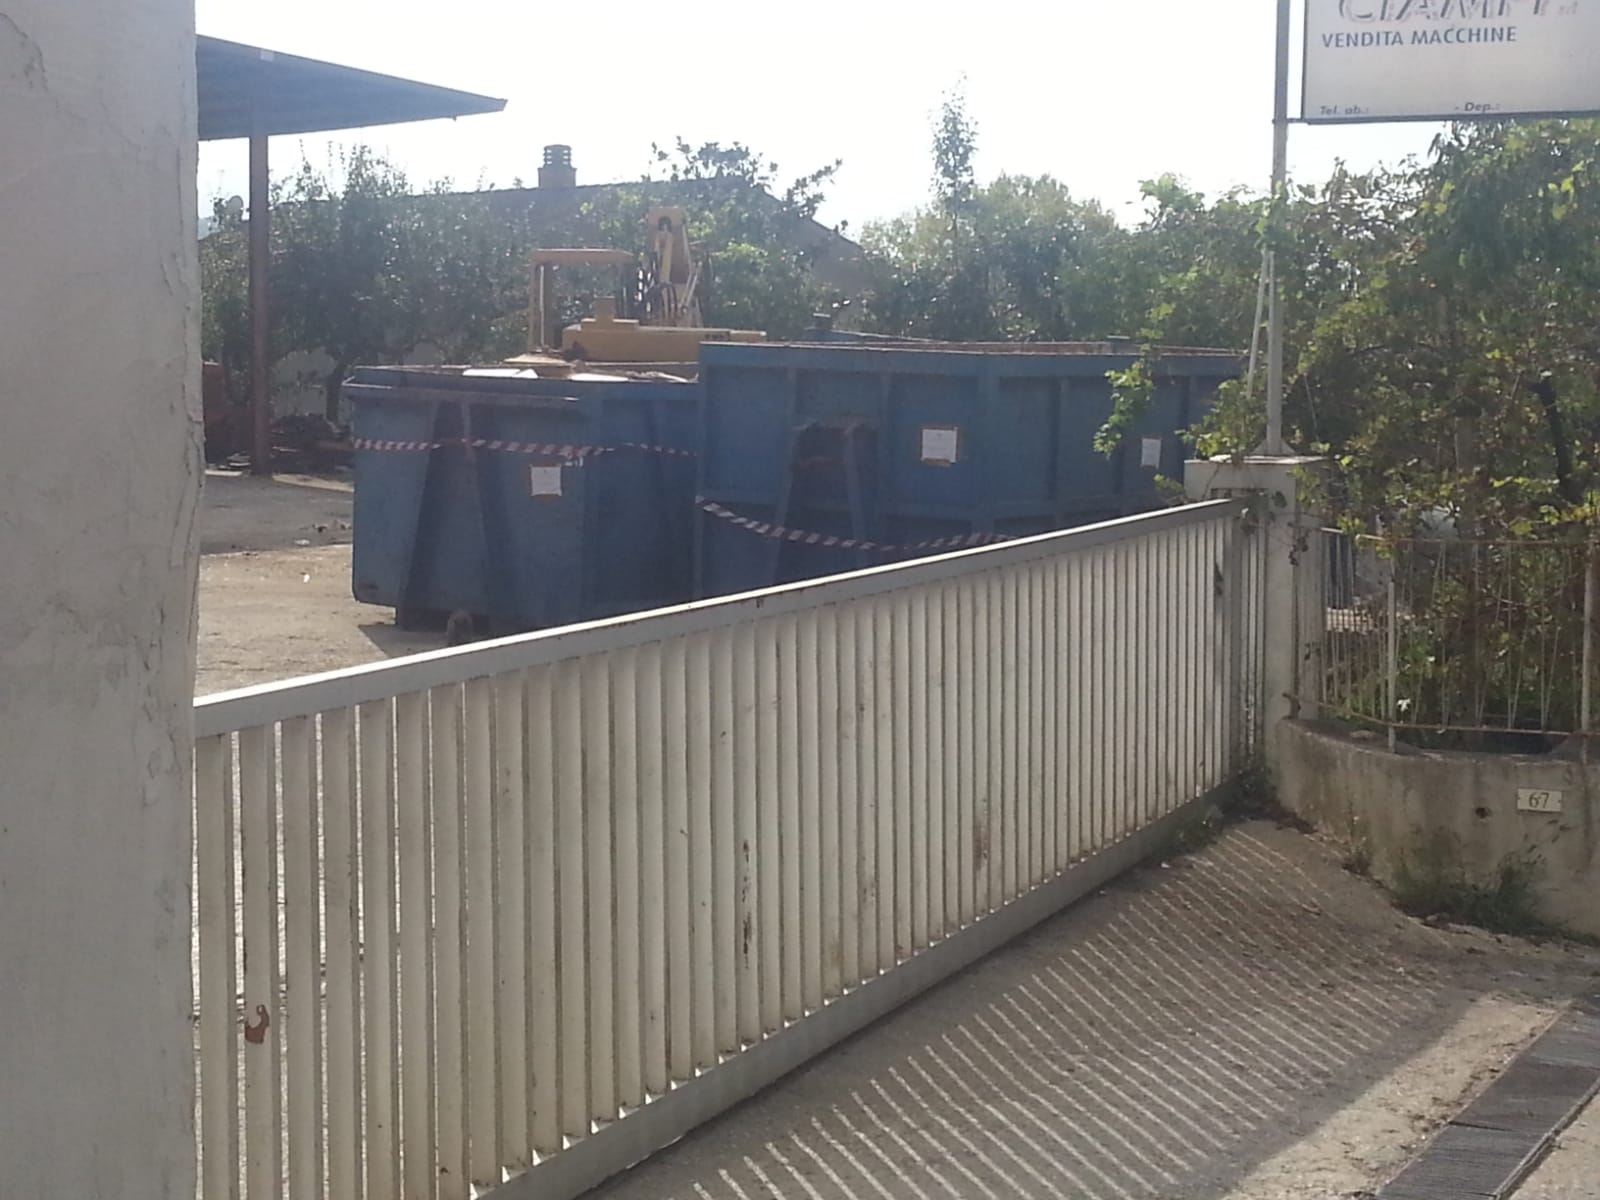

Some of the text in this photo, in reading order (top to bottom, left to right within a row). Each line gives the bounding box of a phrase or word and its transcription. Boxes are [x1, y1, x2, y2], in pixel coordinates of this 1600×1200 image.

[1321, 26, 1517, 48] VENDITA MACCHINE
[1528, 791, 1549, 809] 67
